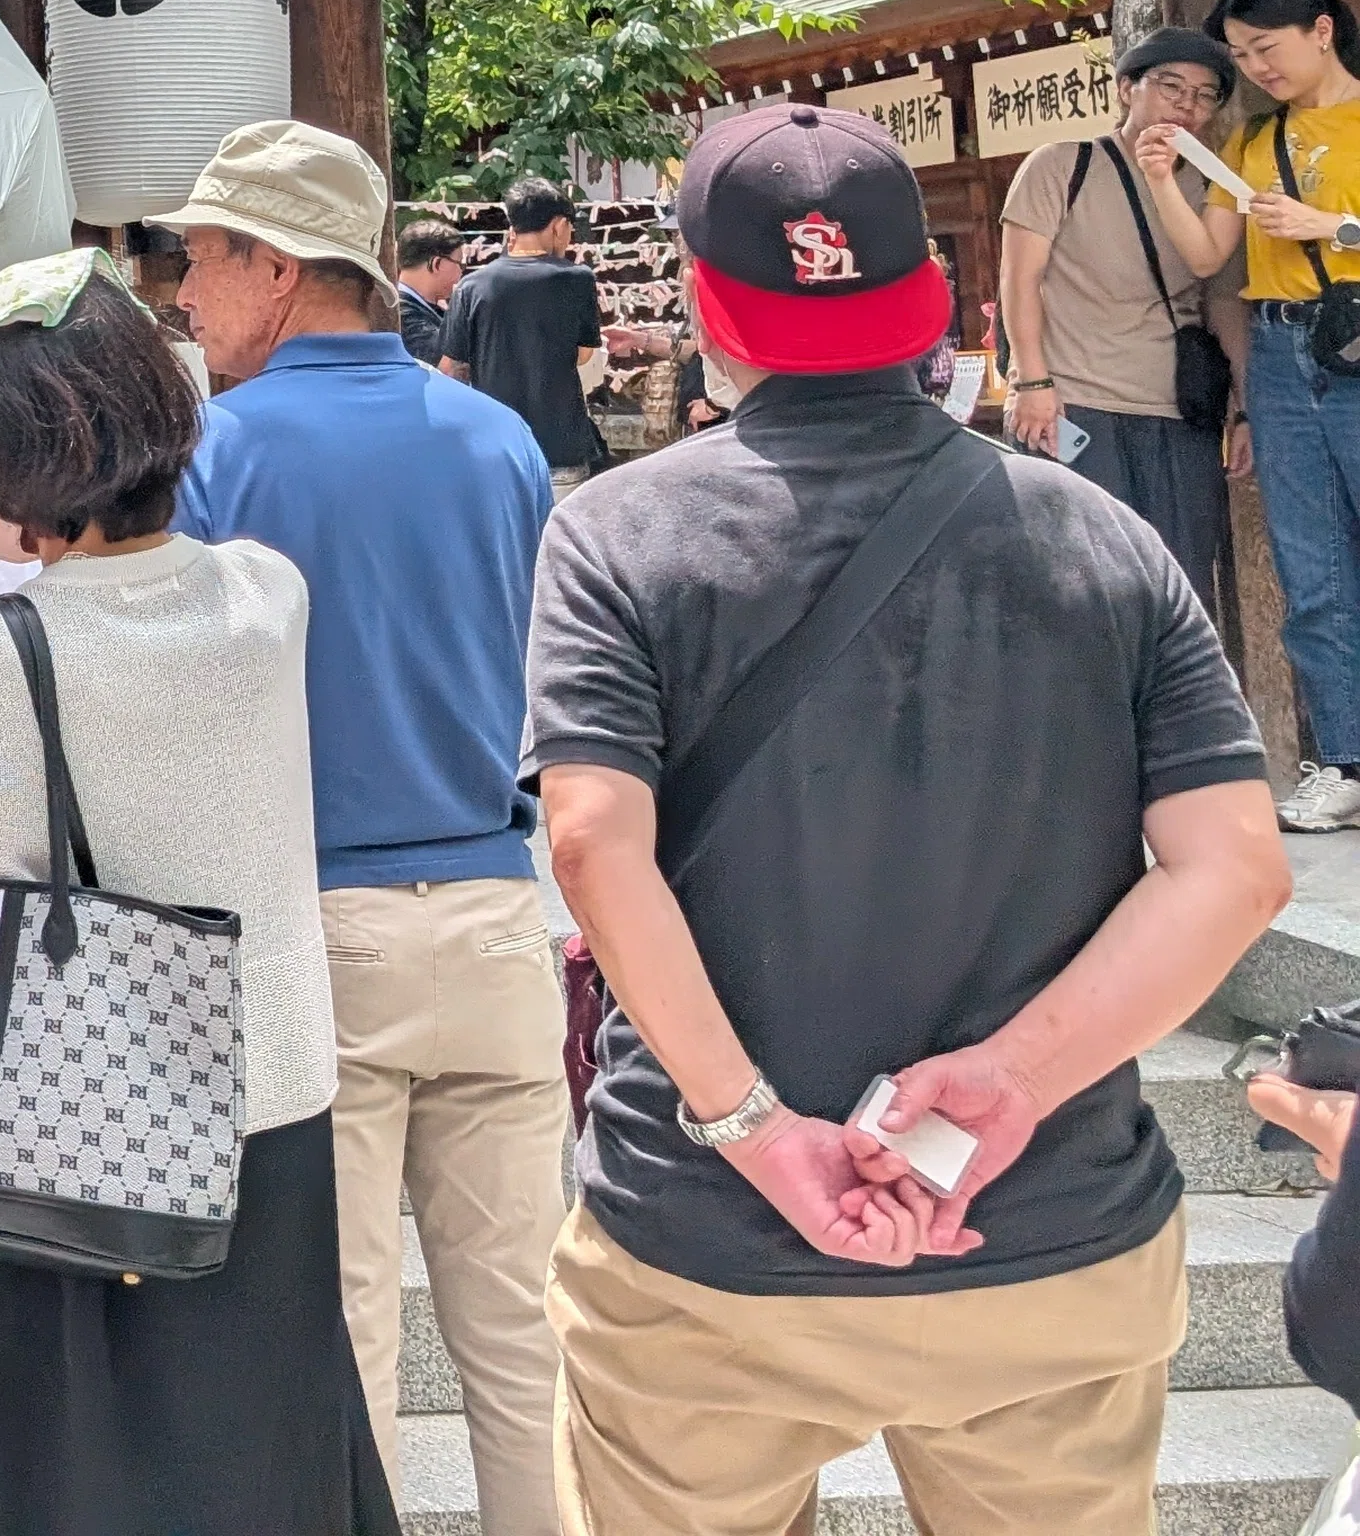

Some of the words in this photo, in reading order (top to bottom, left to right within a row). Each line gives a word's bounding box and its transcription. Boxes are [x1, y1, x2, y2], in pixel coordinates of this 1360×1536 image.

[987, 62, 1114, 132] 御祈願受付
